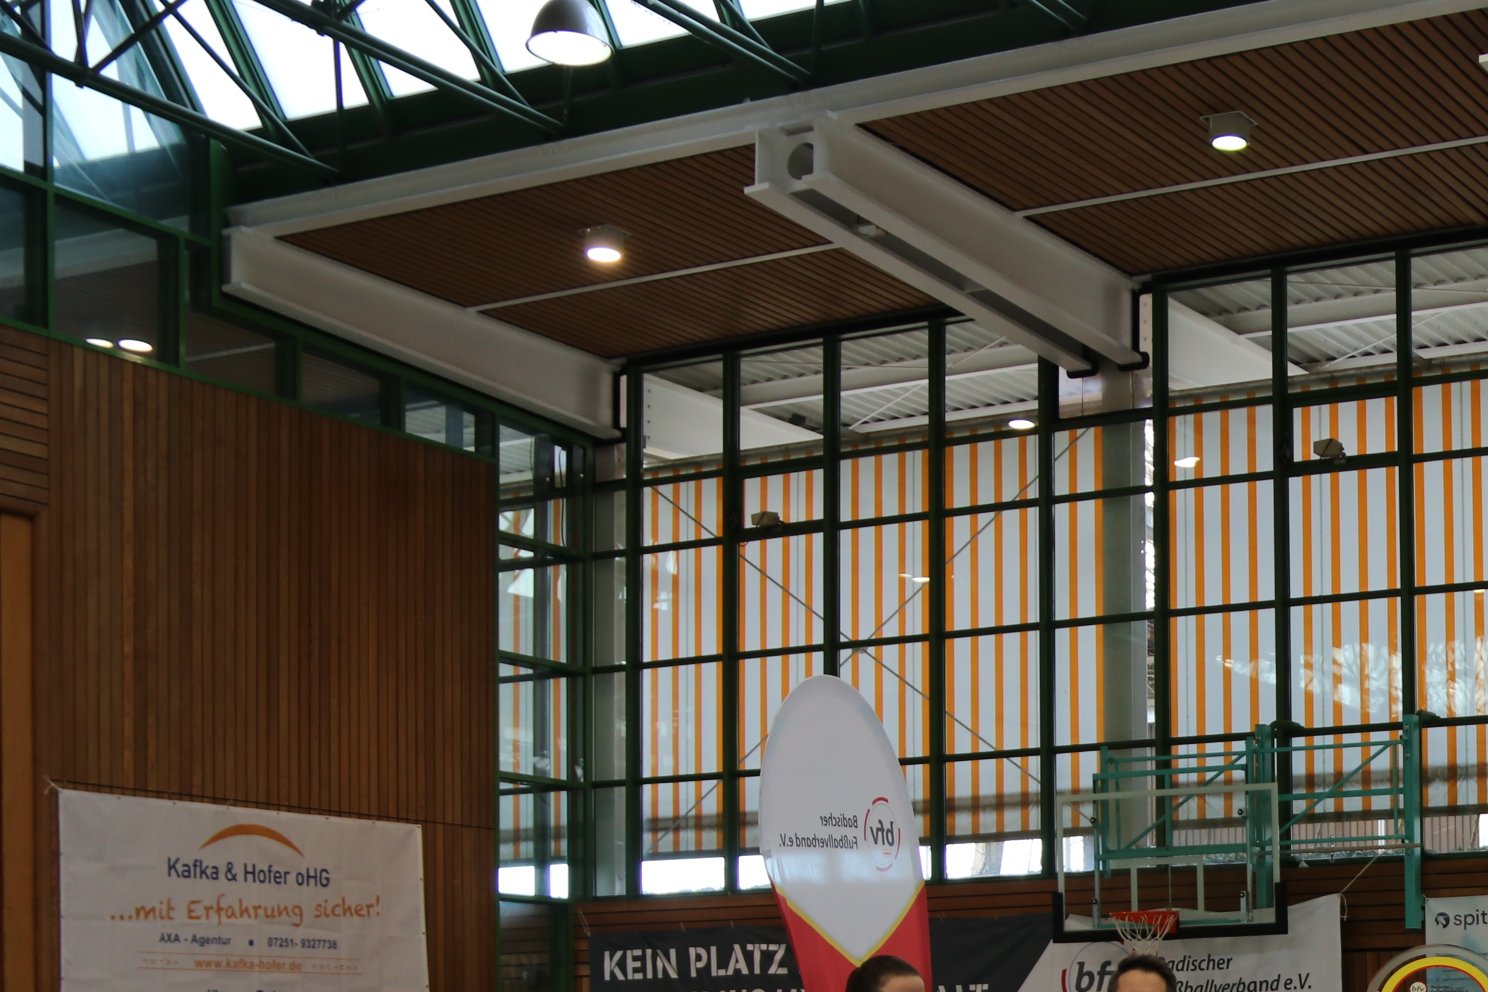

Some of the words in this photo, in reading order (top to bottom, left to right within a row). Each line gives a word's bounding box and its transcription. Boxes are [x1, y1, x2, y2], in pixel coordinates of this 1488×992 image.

[167, 857, 219, 881] Kafka
[225, 861, 238, 882] &
[243, 863, 290, 885] Hofer
[295, 867, 331, 888] oHG
[110, 897, 175, 920] ...mit
[187, 893, 304, 928] Erfahrung
[314, 894, 380, 919] sicher!
[159, 932, 181, 944] AXA
[190, 933, 232, 947] Agentur
[193, 957, 304, 972] www.kafka-hofer.de
[603, 947, 679, 981] KEIN
[688, 943, 789, 978] PLATZ
[1284, 973, 1313, 991] e.V.
